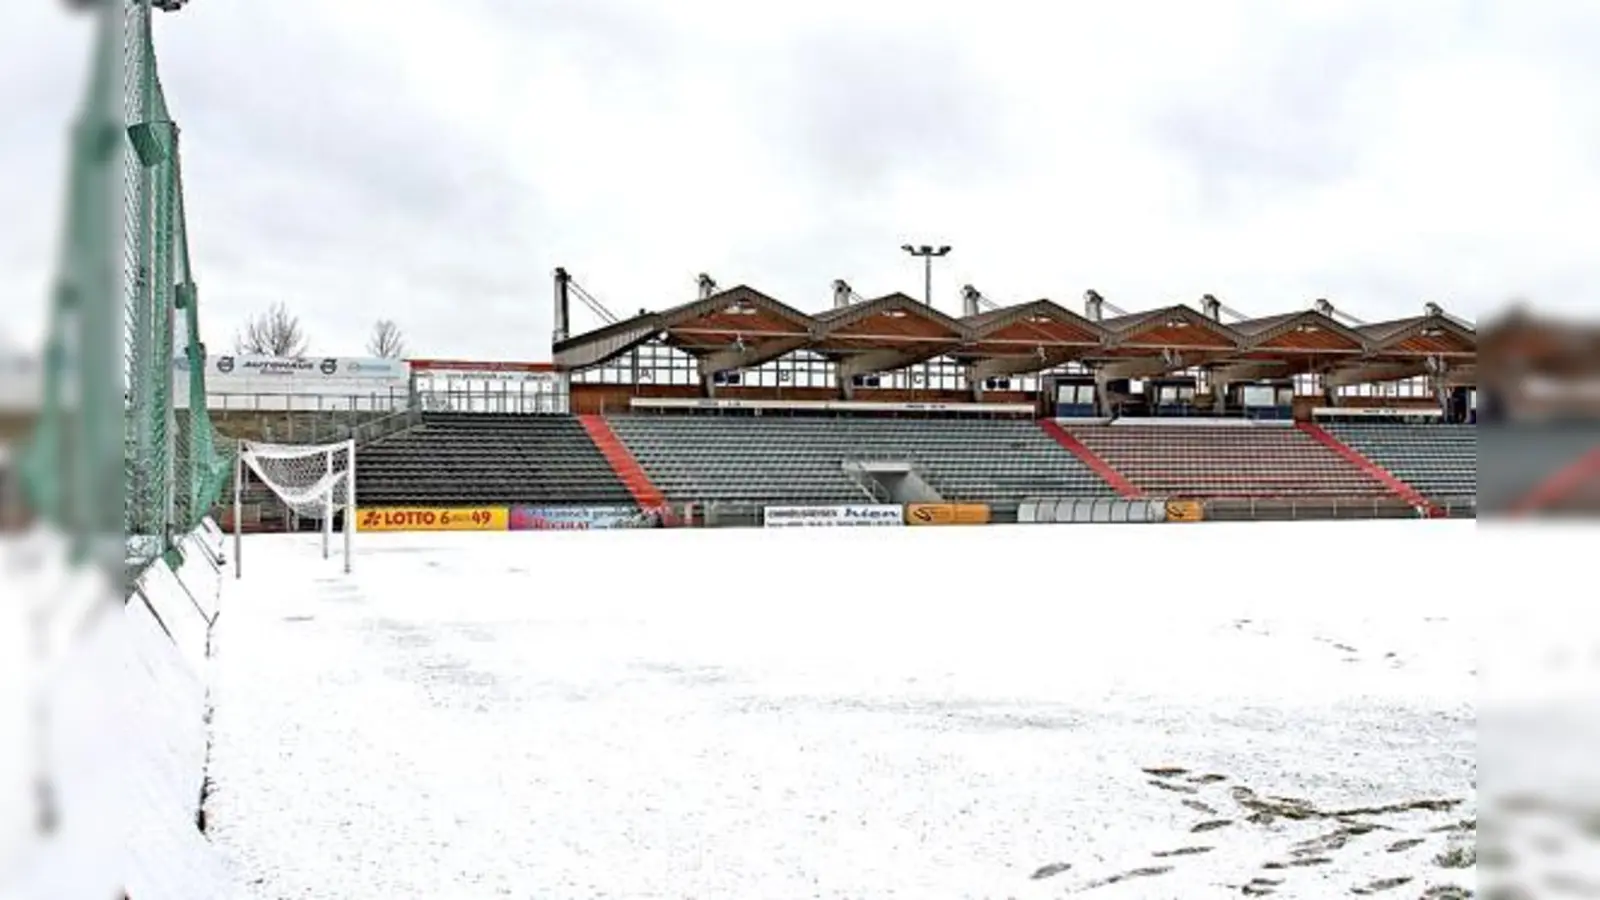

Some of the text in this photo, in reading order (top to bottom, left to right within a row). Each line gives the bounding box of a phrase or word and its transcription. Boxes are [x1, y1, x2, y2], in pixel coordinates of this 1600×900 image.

[384, 511, 437, 526] LOTTO
[440, 511, 450, 525] 6
[472, 511, 492, 525] 49
